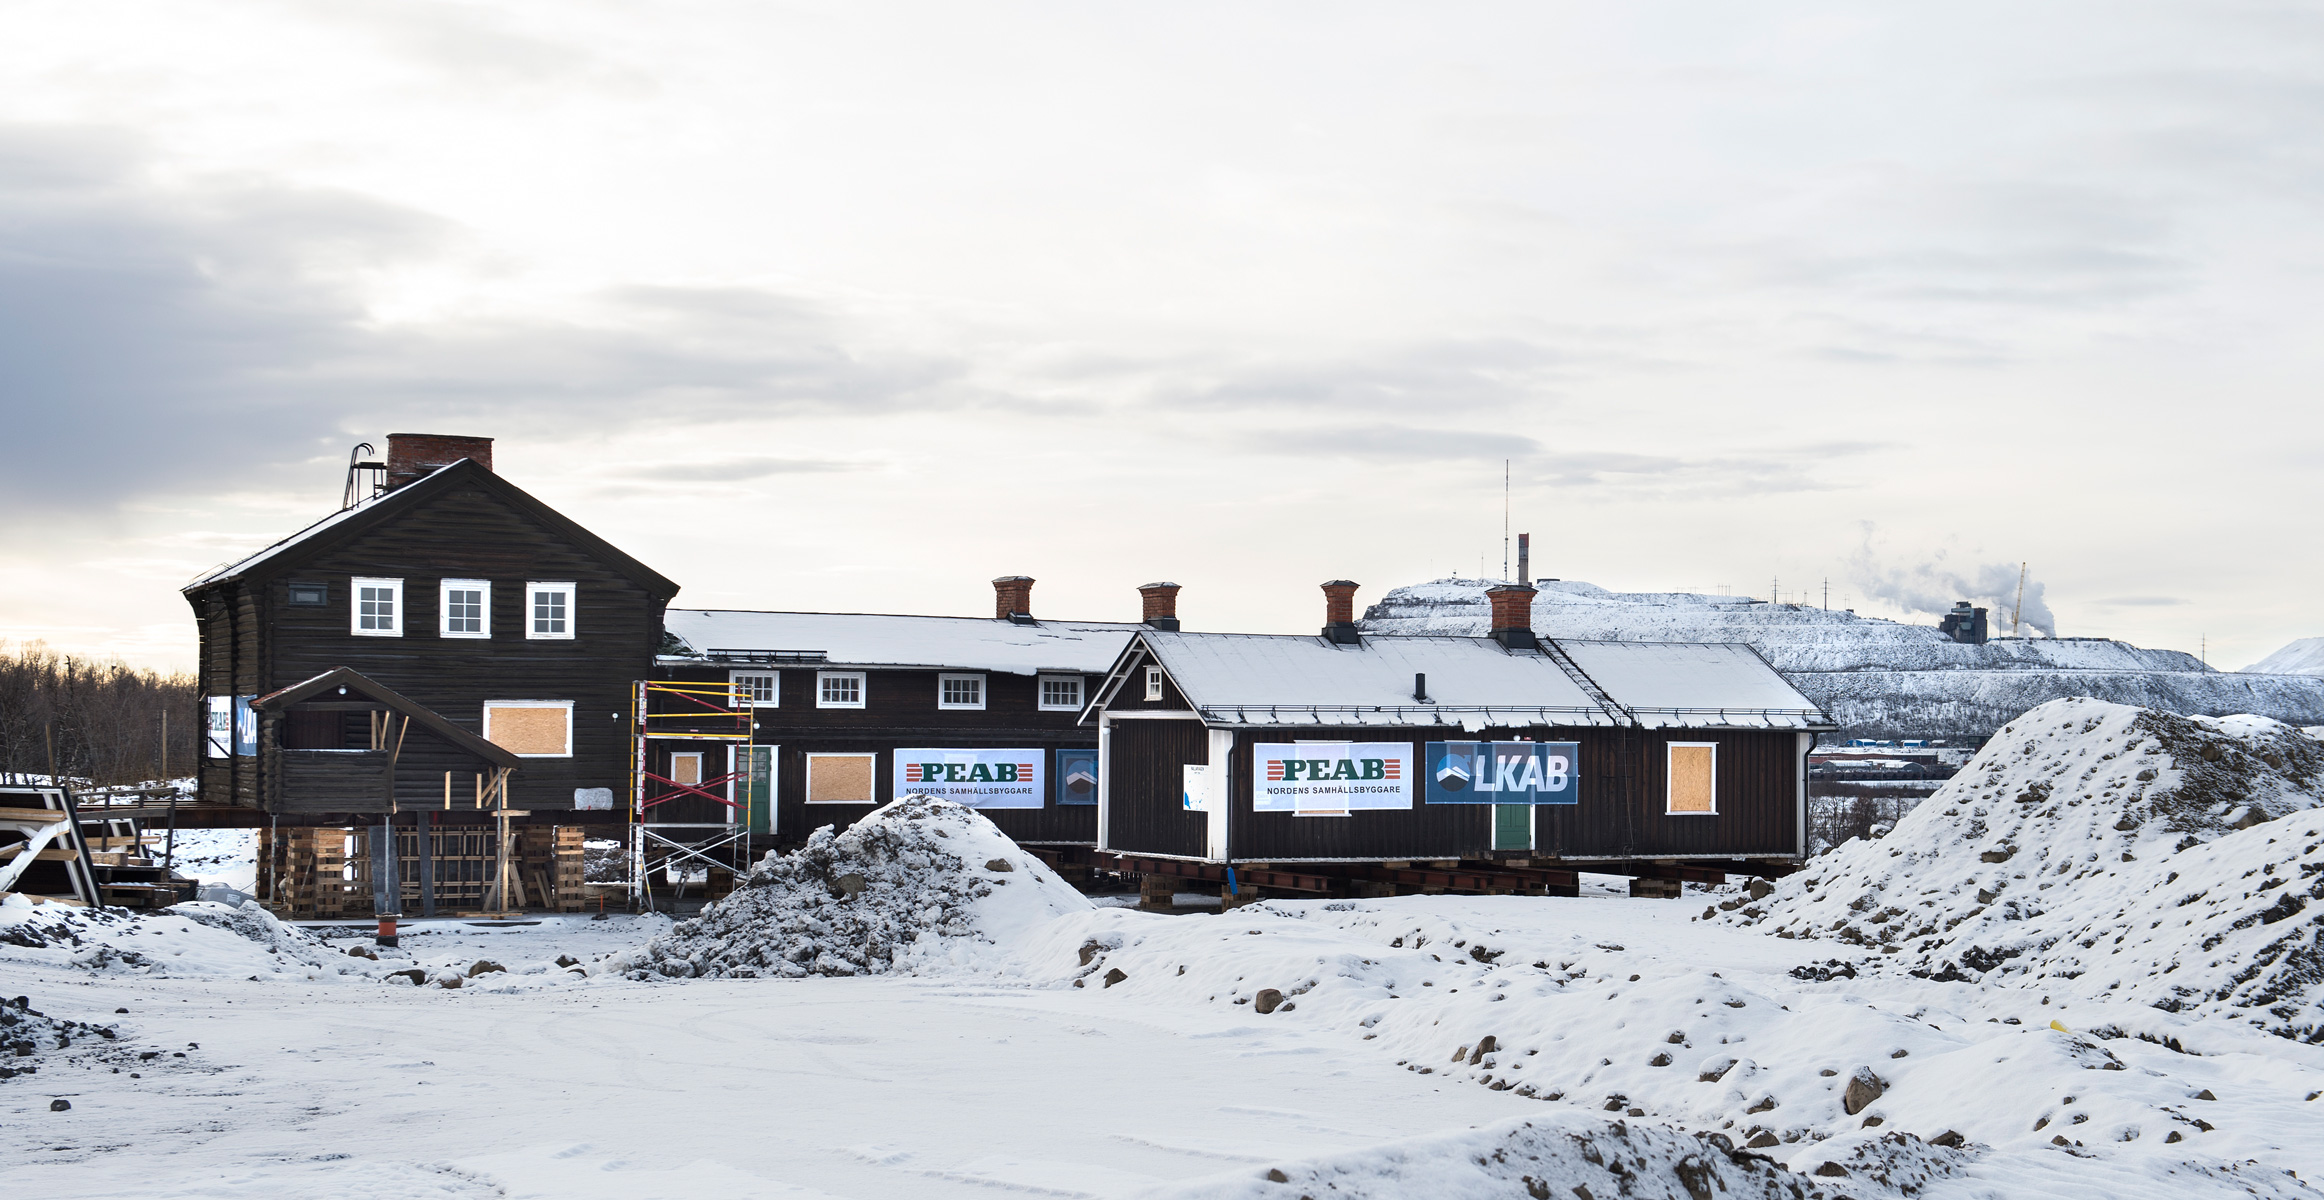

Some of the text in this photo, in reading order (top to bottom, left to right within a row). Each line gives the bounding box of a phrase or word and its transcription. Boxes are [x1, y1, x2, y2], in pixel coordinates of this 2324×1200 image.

[920, 763, 1018, 782] PEAB
[1282, 759, 1385, 781] PEAB
[1474, 755, 1569, 792] LKAB
[949, 786, 1033, 795] SAMHÄLLSBYGGARE
[1267, 785, 1400, 795] NORDENS SAMHÄLLSBYGGARE
